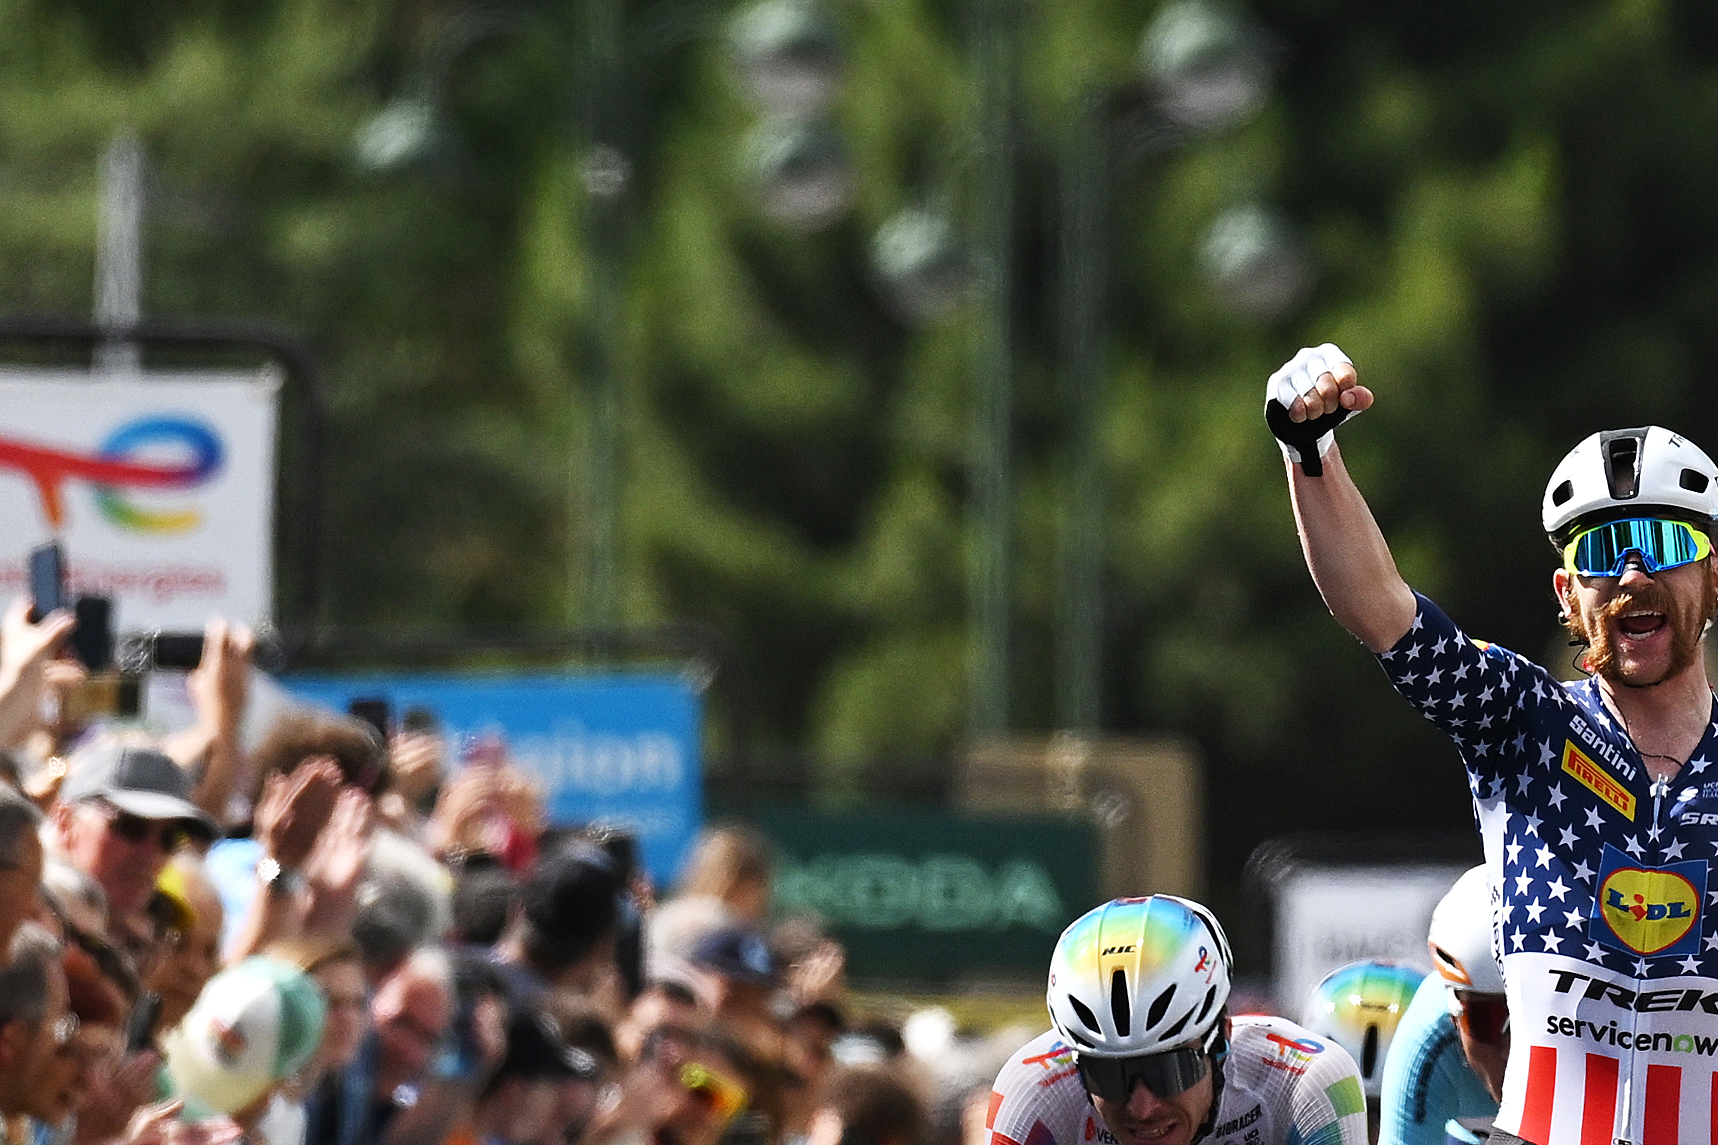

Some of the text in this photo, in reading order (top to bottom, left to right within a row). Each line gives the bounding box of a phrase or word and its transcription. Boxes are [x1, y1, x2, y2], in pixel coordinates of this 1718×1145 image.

[1568, 713, 1637, 782] Santini
[1567, 749, 1631, 812] PIRELLI
[1102, 944, 1137, 956] HJC
[1097, 1128, 1119, 1145] VEN
